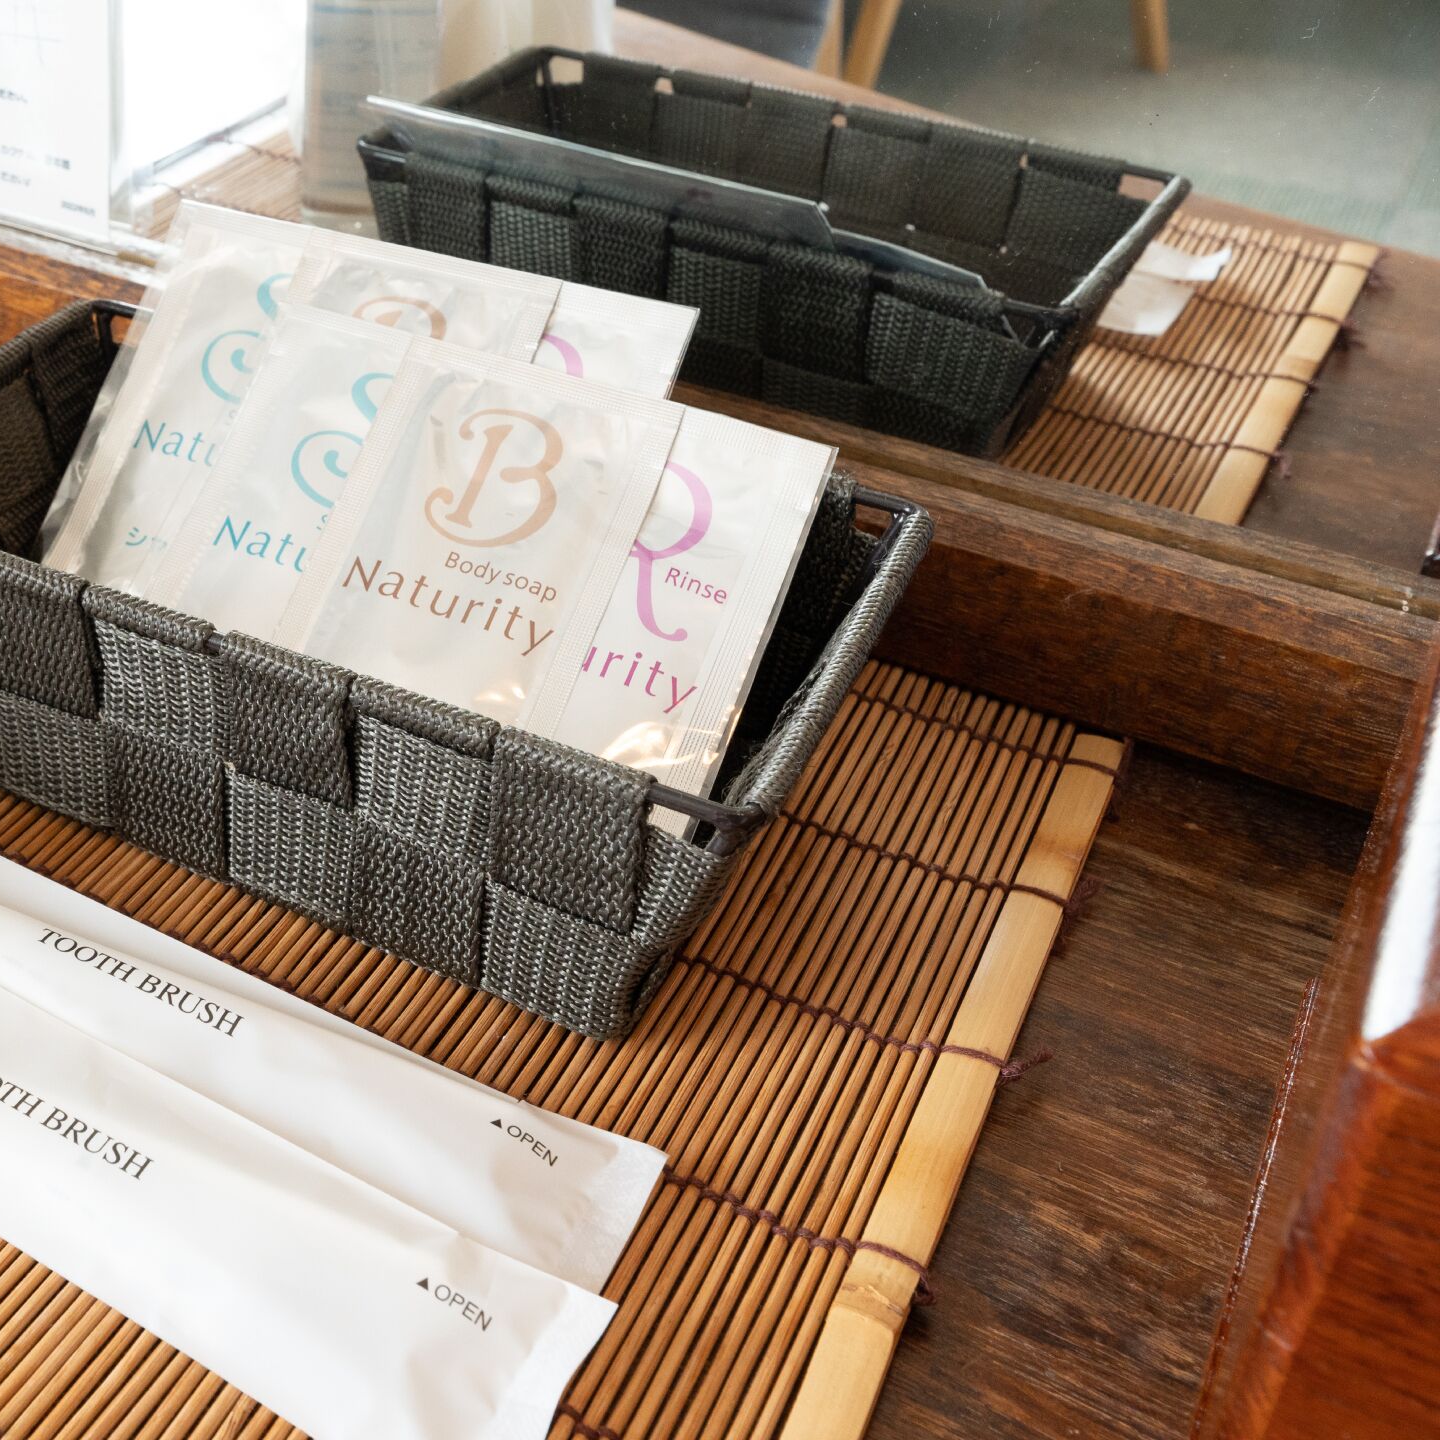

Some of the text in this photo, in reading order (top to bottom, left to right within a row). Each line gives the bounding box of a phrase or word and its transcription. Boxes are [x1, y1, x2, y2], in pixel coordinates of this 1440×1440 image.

[424, 408, 563, 548] B
[341, 555, 555, 658] Naturity
[444, 550, 558, 604] Body soap
[663, 566, 729, 605] Rinse
[37, 927, 245, 1037] TOOTH BRUSH
[40, 1106, 155, 1181] BRUSH
[506, 1124, 559, 1168] OPEN
[434, 1283, 493, 1332] OPEN
